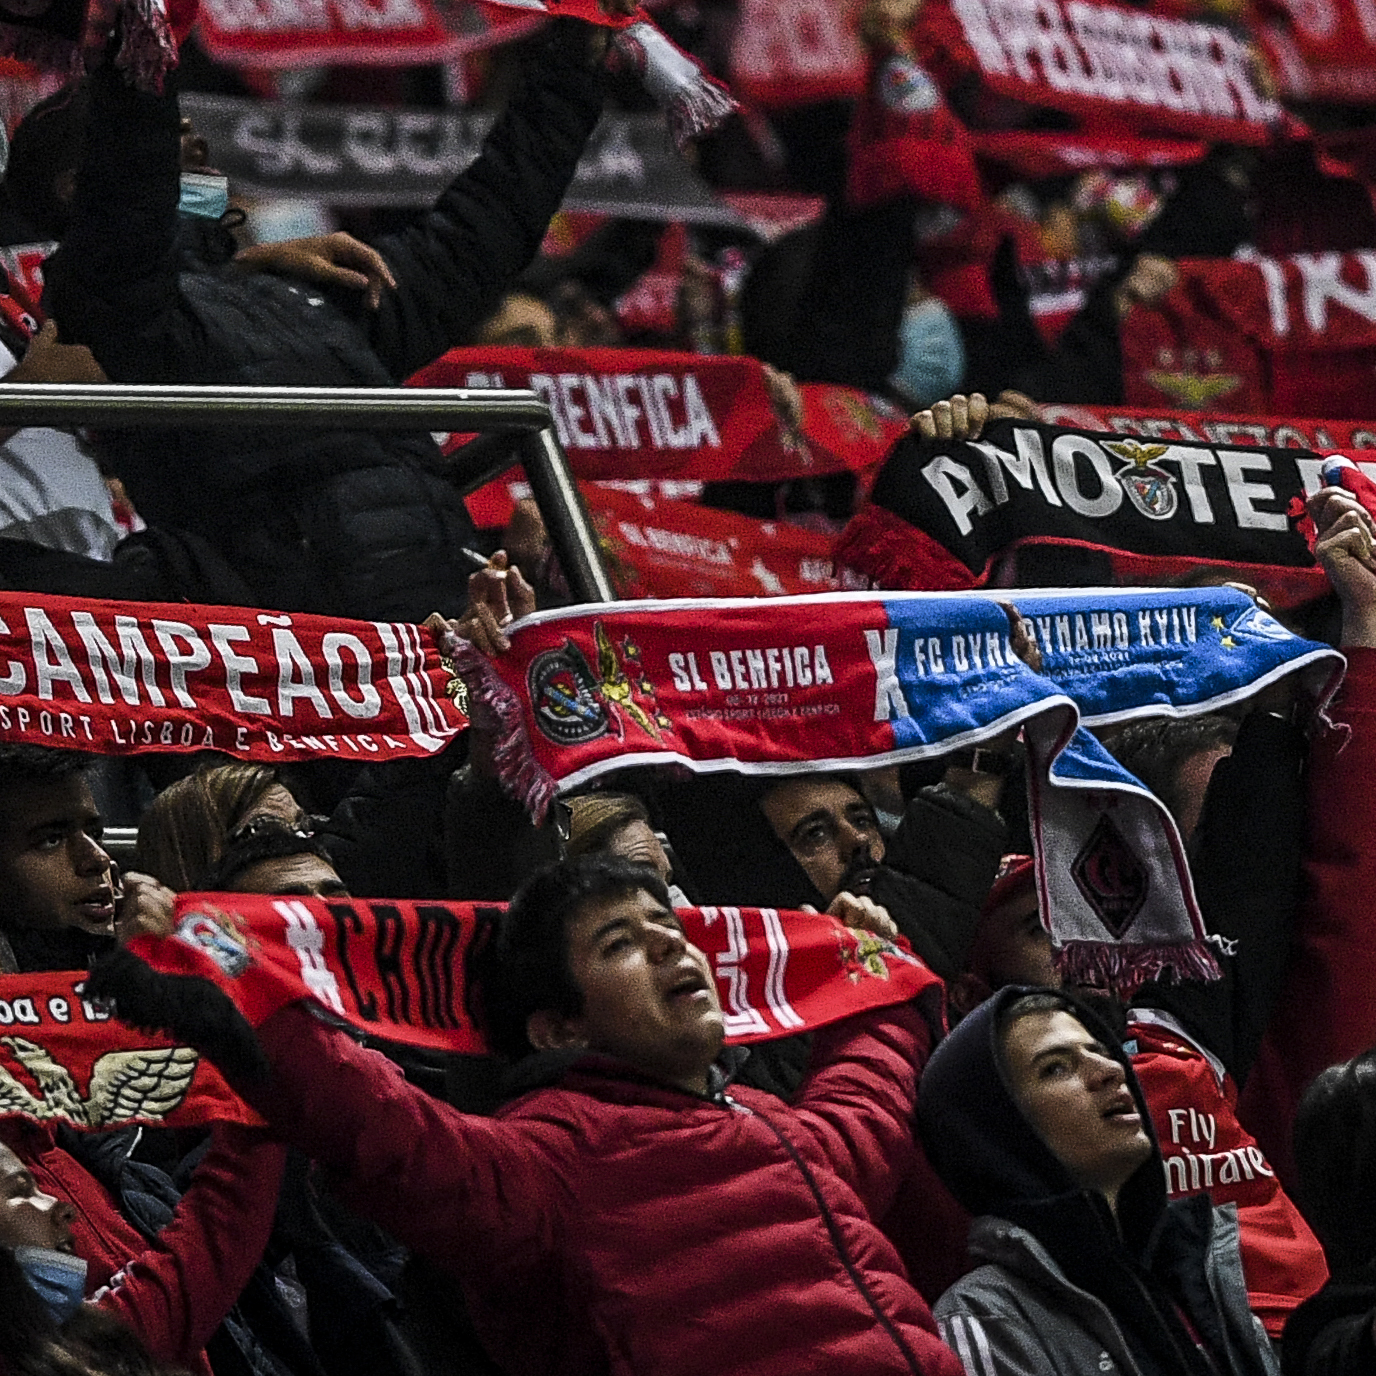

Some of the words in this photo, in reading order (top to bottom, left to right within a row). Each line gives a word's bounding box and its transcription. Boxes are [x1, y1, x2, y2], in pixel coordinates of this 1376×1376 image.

[922, 428, 1125, 537] AMO
[1161, 442, 1292, 534] TE
[1137, 606, 1197, 647] KYIV
[667, 651, 708, 692] SL
[709, 644, 834, 691] BENFICA
[862, 627, 910, 722] X
[913, 637, 945, 676] FC
[109, 718, 219, 748] LISBOA
[234, 727, 251, 751] E
[268, 731, 407, 753] BENFICA
[48, 997, 70, 1023] e
[1167, 1107, 1216, 1150] Fly
